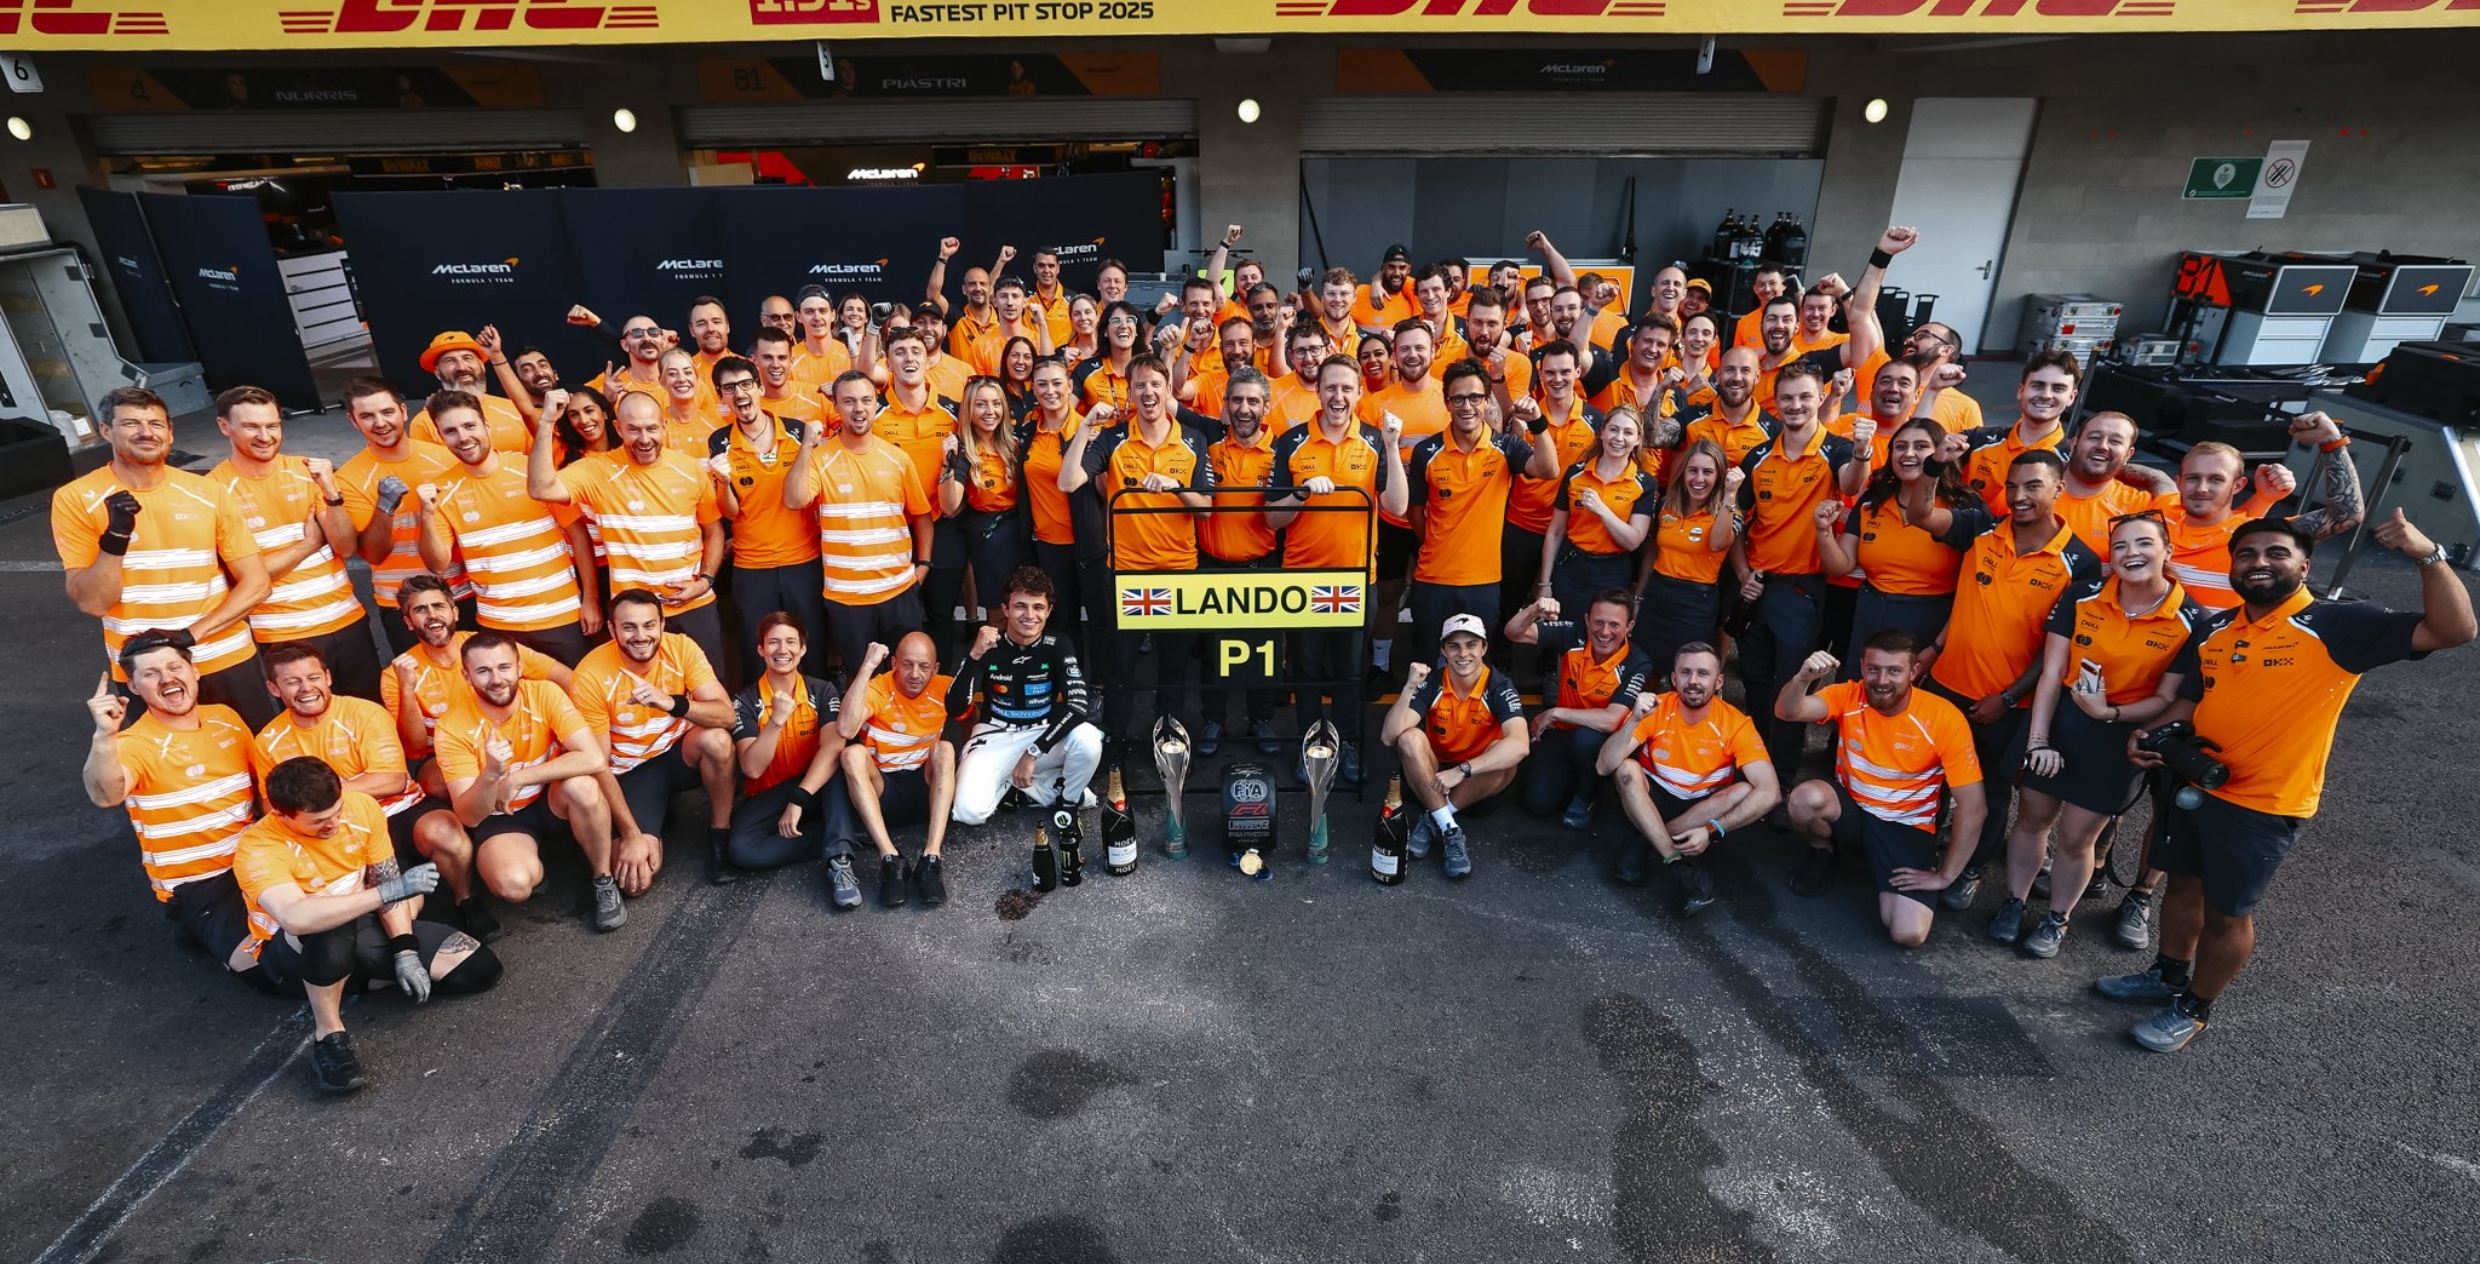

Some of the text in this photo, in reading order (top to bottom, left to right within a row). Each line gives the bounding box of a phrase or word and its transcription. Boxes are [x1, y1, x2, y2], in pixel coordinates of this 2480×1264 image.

[891, 4, 988, 22] FASTEST
[993, 3, 1030, 21] PIT
[1036, 2, 1093, 20] STOP
[1099, 1, 1154, 19] 2025
[821, 45, 830, 68] 5
[14, 59, 29, 81] 6
[1540, 64, 1606, 73] McLaren
[734, 69, 766, 91] 81
[882, 78, 967, 89] PIASTRI
[276, 90, 358, 101] NORRIS
[847, 168, 918, 179] McLaren
[1053, 244, 1097, 255] cLaren
[432, 264, 511, 274] McLaren
[656, 260, 724, 270] McLare
[808, 264, 881, 274] McLaren
[1169, 467, 1187, 475] OKX
[1983, 556, 1998, 568] DELL
[2030, 578, 2053, 591] OKX
[1176, 585, 1307, 615] LANDO
[2081, 619, 2099, 629] DELL
[2146, 640, 2169, 651] OKX
[1219, 639, 1275, 678] P1
[2263, 657, 2294, 667] OKX
[989, 673, 1013, 682] Android
